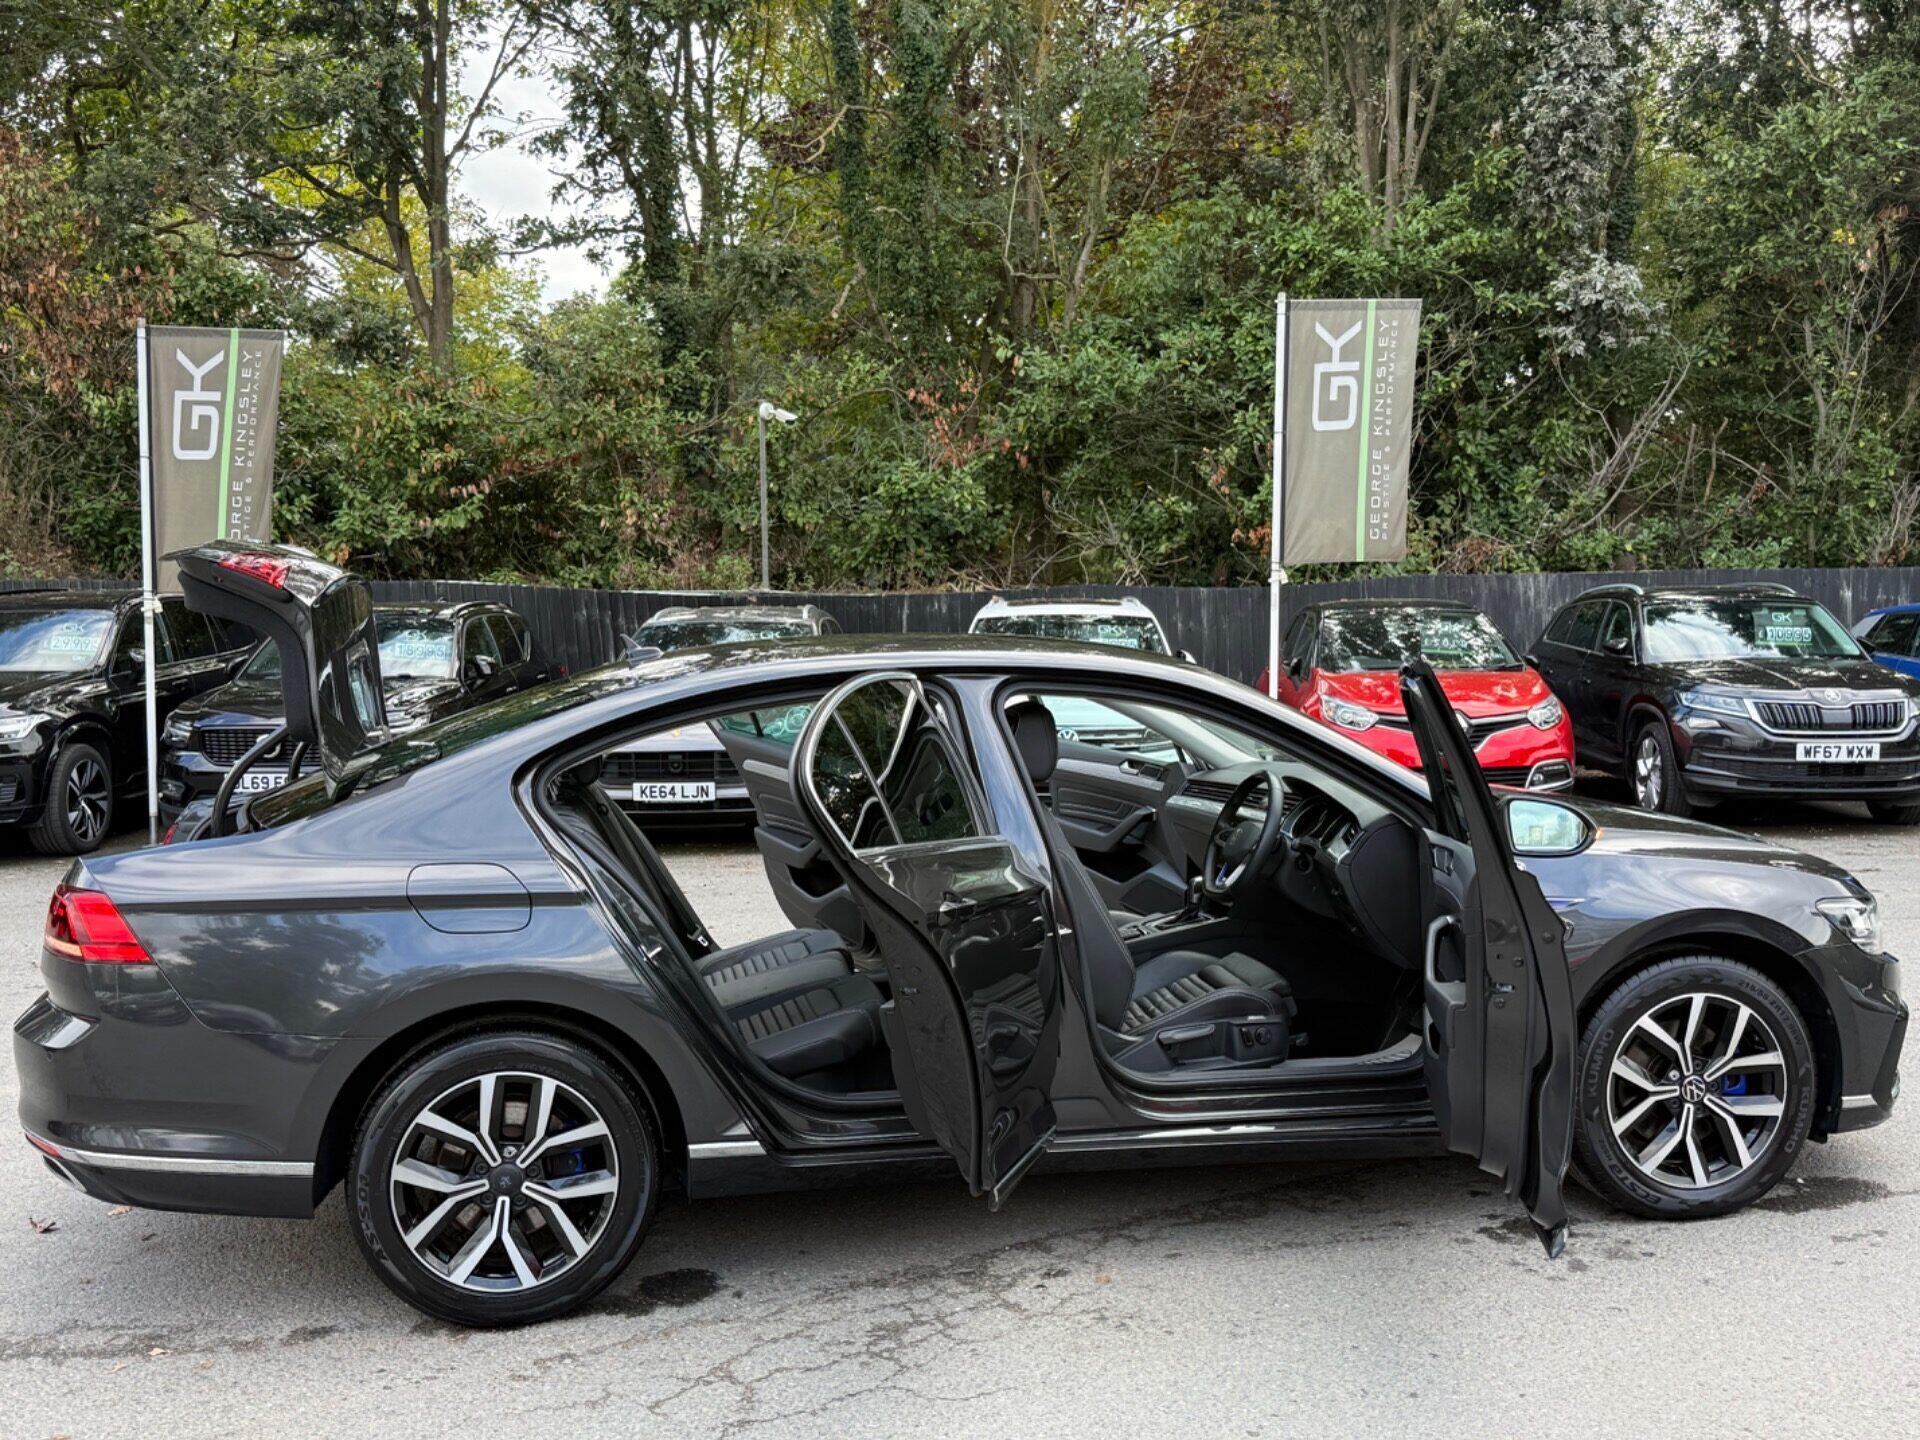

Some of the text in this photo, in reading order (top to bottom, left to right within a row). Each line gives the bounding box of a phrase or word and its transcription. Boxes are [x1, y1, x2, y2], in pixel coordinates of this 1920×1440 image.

[173, 348, 225, 461] GK
[247, 351, 262, 467] PERFORMANCE
[1312, 320, 1362, 431] GK
[1385, 320, 1398, 436] PERFORMANCE
[231, 351, 253, 540] ORGE KINGSLEY
[1369, 320, 1389, 540] GEORGE KINGSLEY
[1382, 464, 1390, 540] PRESTIGE
[1772, 612, 1791, 622] GK
[640, 785, 709, 799] KE64 LJN
[1803, 745, 1874, 759] WF67 WXW
[1587, 1029, 1614, 1097] KUMHO
[1784, 1086, 1810, 1153] KUMHO
